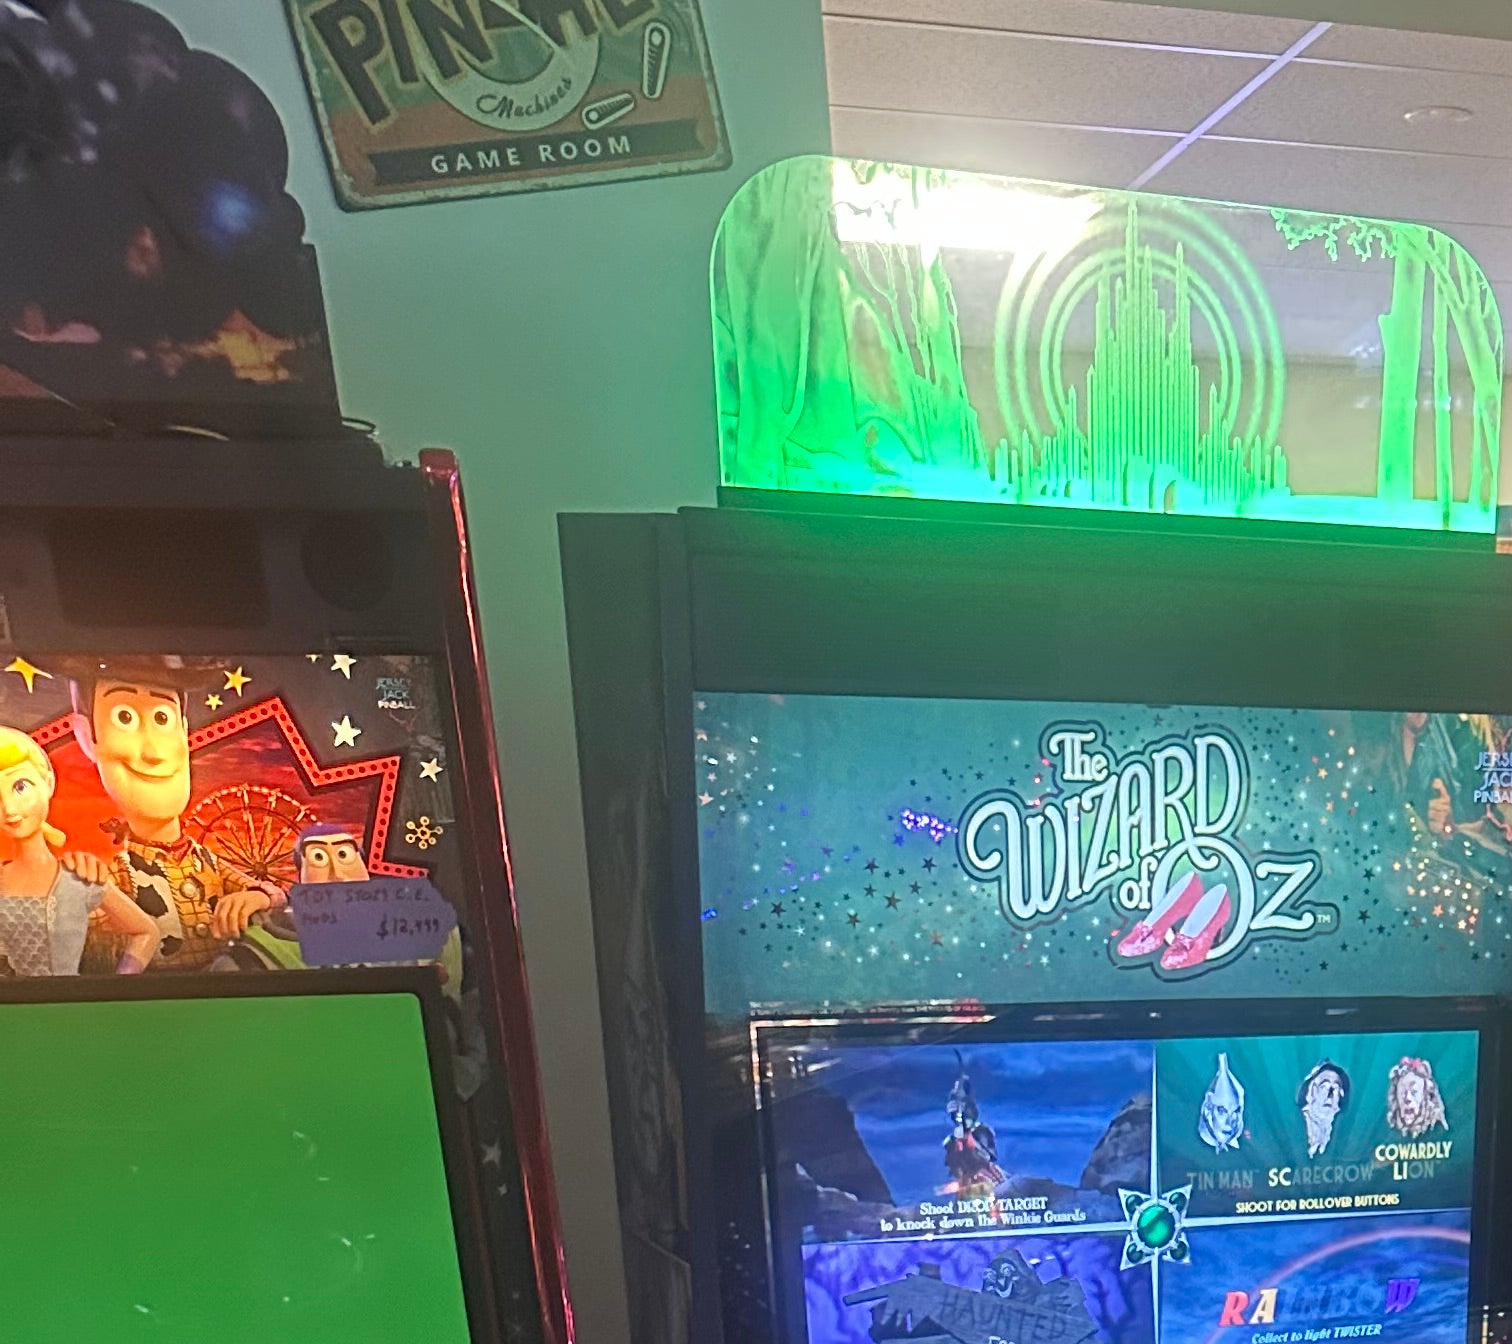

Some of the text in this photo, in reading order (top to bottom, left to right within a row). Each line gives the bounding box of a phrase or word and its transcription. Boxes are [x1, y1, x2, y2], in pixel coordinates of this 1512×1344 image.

[475, 78, 572, 118] Machines
[431, 135, 632, 174] GAME ROOM
[1047, 731, 1110, 783] The
[964, 733, 1245, 920] WIZARD
[1118, 856, 1160, 911] of
[1375, 1141, 1452, 1162] COWARDLY
[1187, 1171, 1253, 1190] TIN MAN
[1268, 1164, 1374, 1188] SCARECROW
[1393, 1160, 1435, 1181] LION
[920, 1201, 954, 1216] Shoot
[999, 1196, 1049, 1211] TARGET
[1236, 1193, 1400, 1214] SHOOT FOR ROLLOVER BUTTONS
[897, 1216, 936, 1231] knock
[940, 1215, 974, 1230] down
[1000, 1211, 1042, 1226] Winkie
[1044, 1208, 1087, 1223] Guards
[1251, 1331, 1289, 1344] Collect
[1290, 1330, 1303, 1342] to
[1333, 1322, 1383, 1339] TWISTER
